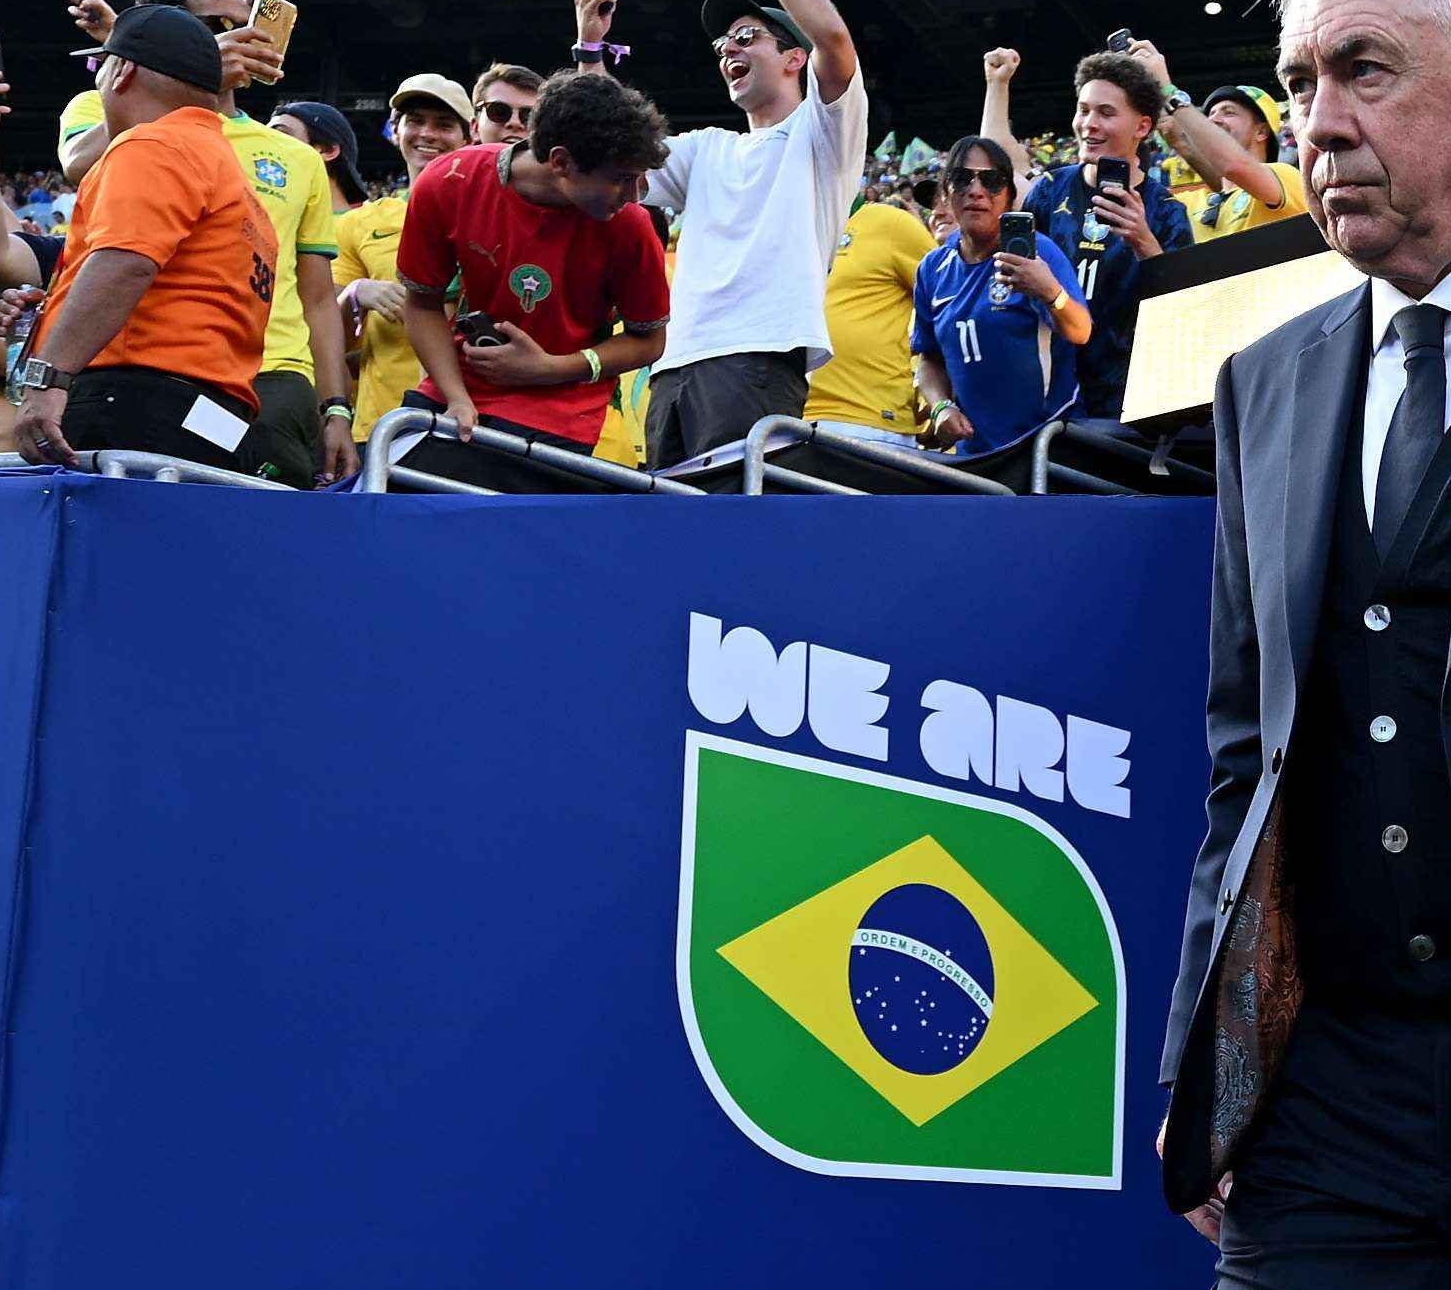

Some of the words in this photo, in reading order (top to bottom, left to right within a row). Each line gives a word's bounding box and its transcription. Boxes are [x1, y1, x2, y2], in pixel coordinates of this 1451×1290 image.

[1077, 258, 1099, 301] 11
[955, 319, 982, 363] 11
[687, 610, 891, 762] WE
[860, 932, 908, 951] ORDEM
[911, 946, 919, 955] E
[921, 948, 989, 1009] PROGRESSO
